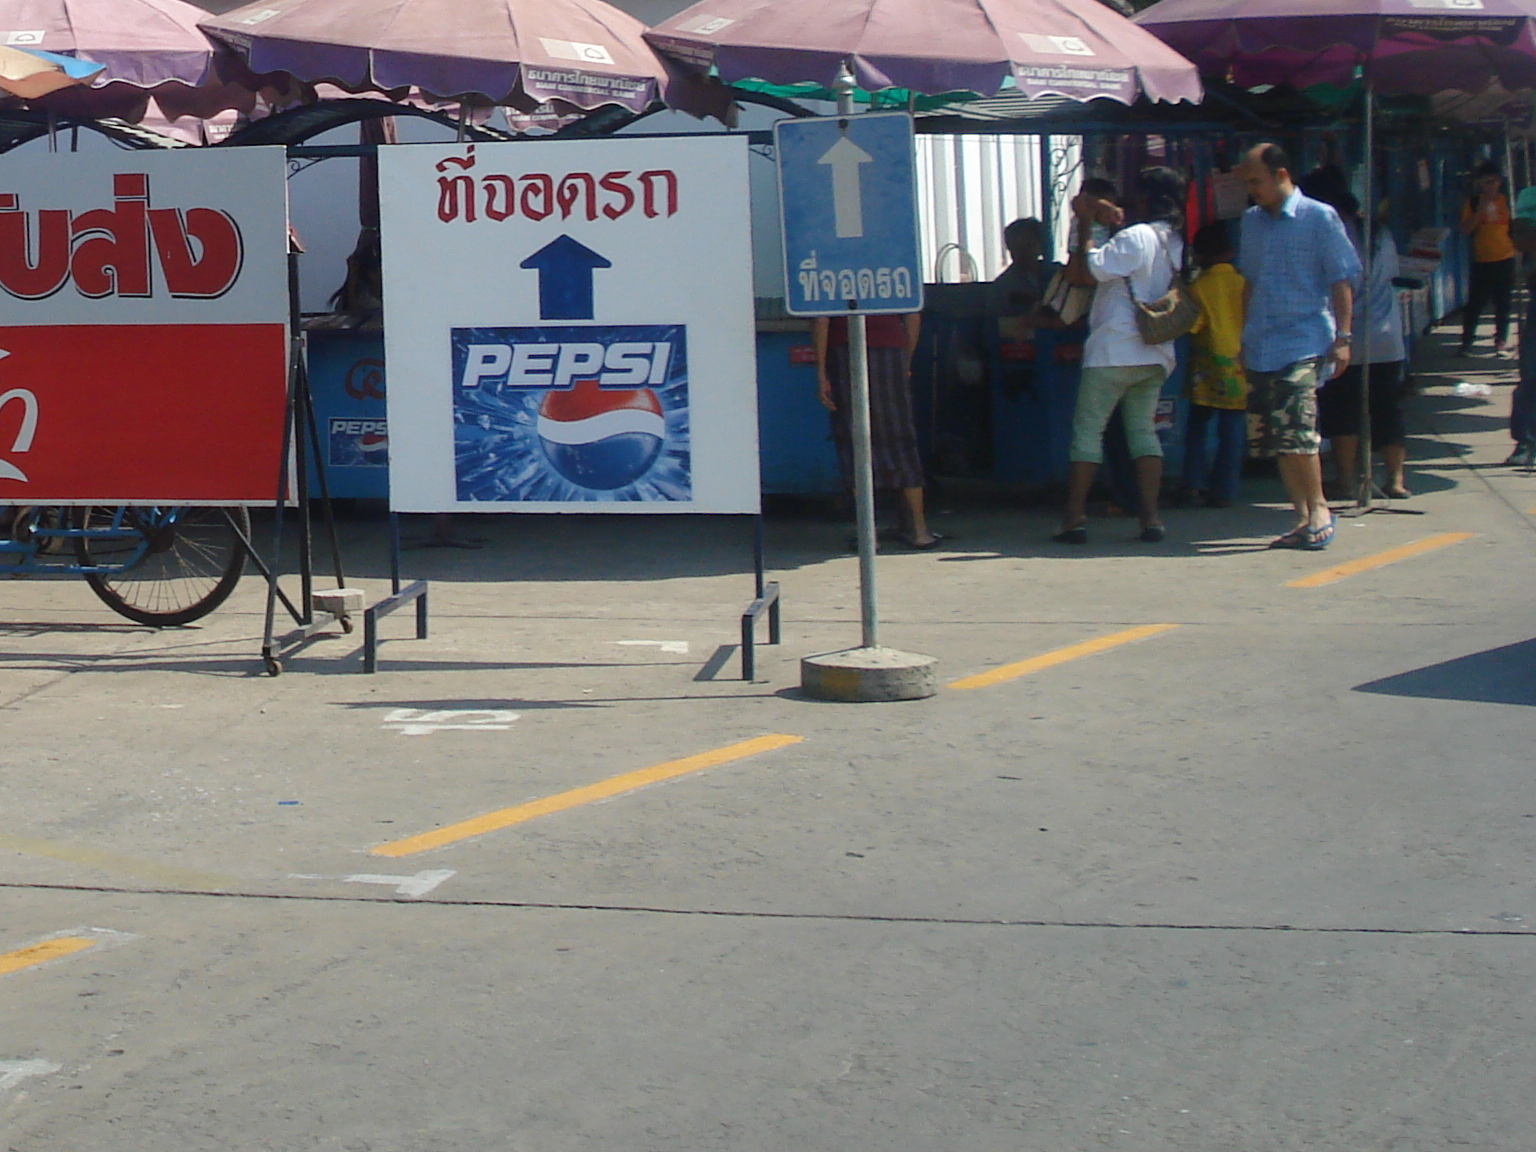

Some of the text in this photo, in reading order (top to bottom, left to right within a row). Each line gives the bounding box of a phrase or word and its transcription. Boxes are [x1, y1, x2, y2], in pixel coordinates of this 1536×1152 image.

[798, 249, 913, 302] ที่จอดรถ
[461, 341, 672, 387] PEPSI
